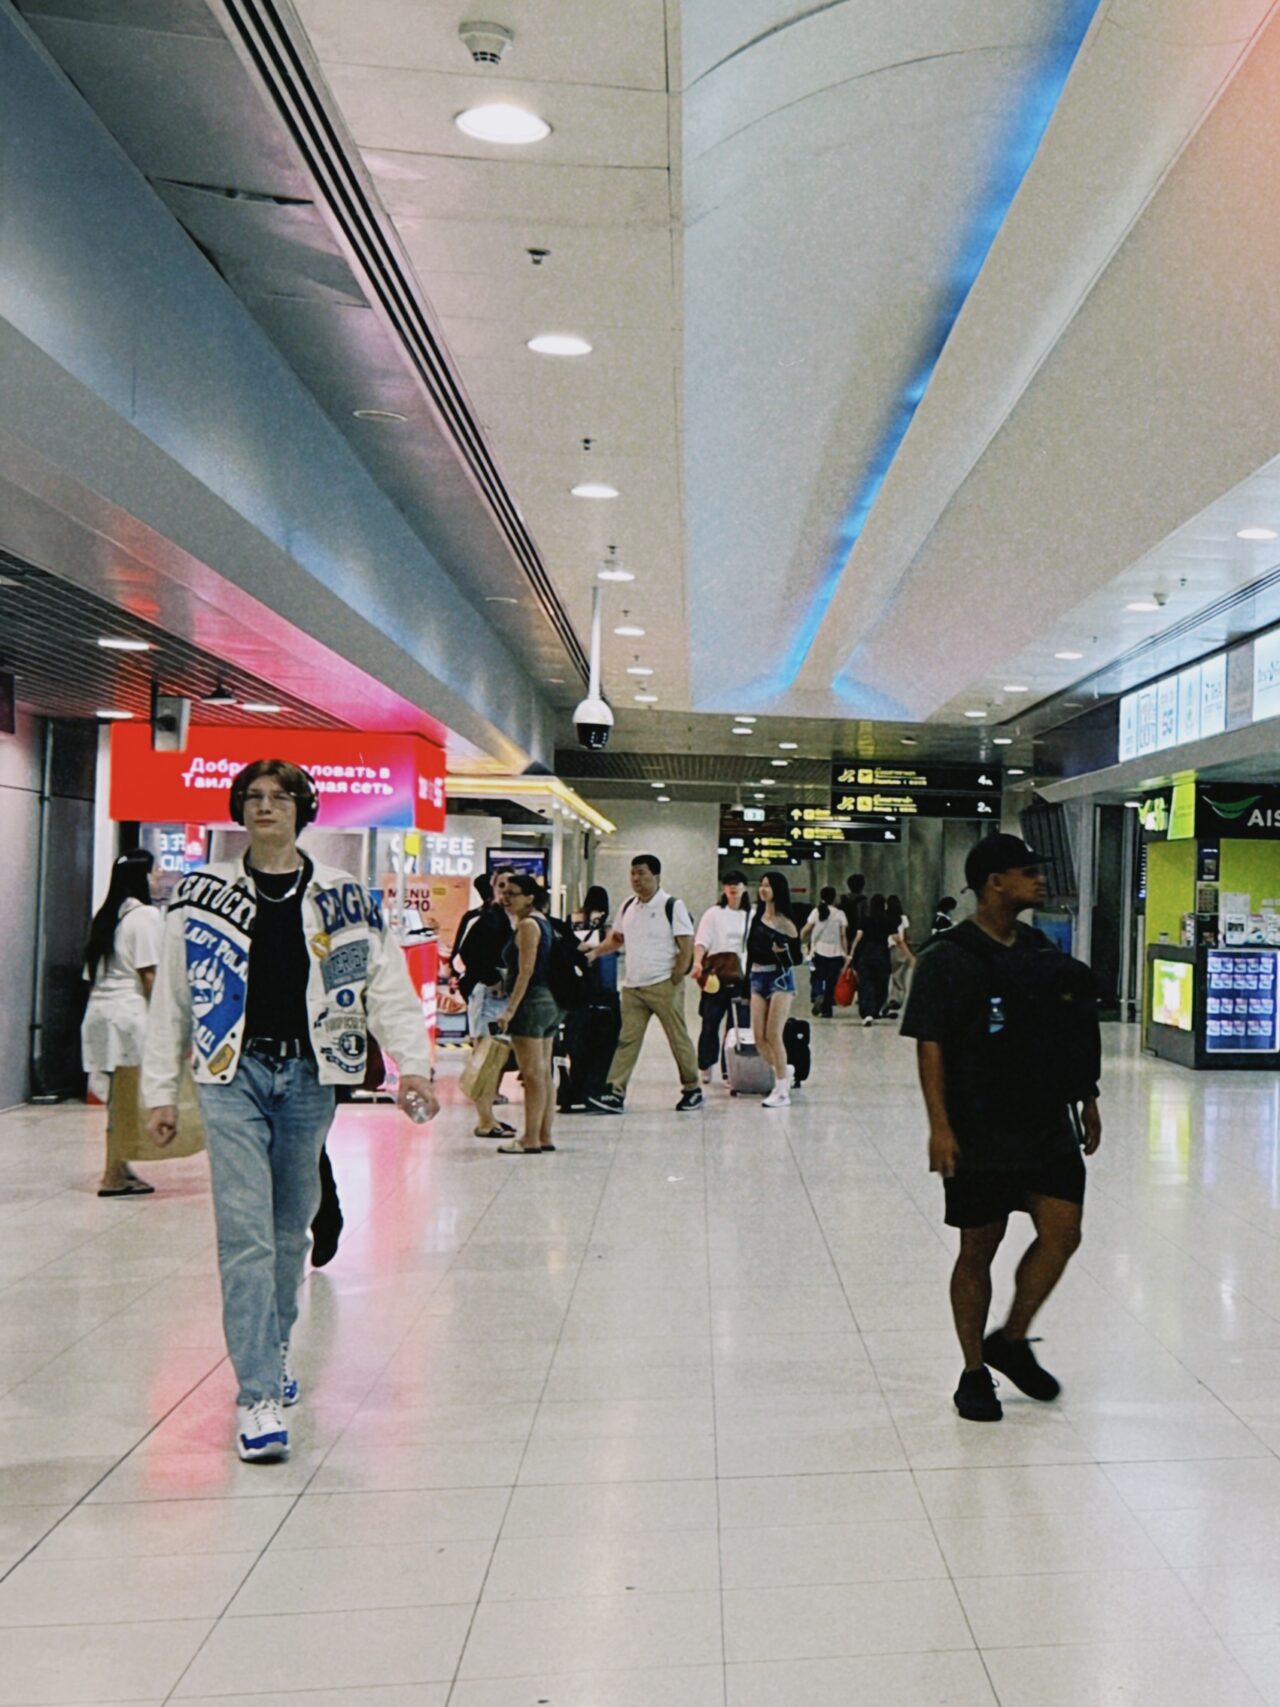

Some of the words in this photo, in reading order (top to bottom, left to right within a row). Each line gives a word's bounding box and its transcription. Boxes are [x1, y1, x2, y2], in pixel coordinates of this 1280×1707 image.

[182, 772, 232, 789] Таил
[350, 781, 394, 796] сеть
[390, 833, 475, 856] CFFEE
[392, 855, 473, 876] WRLD
[179, 873, 257, 931] ENTUCKY
